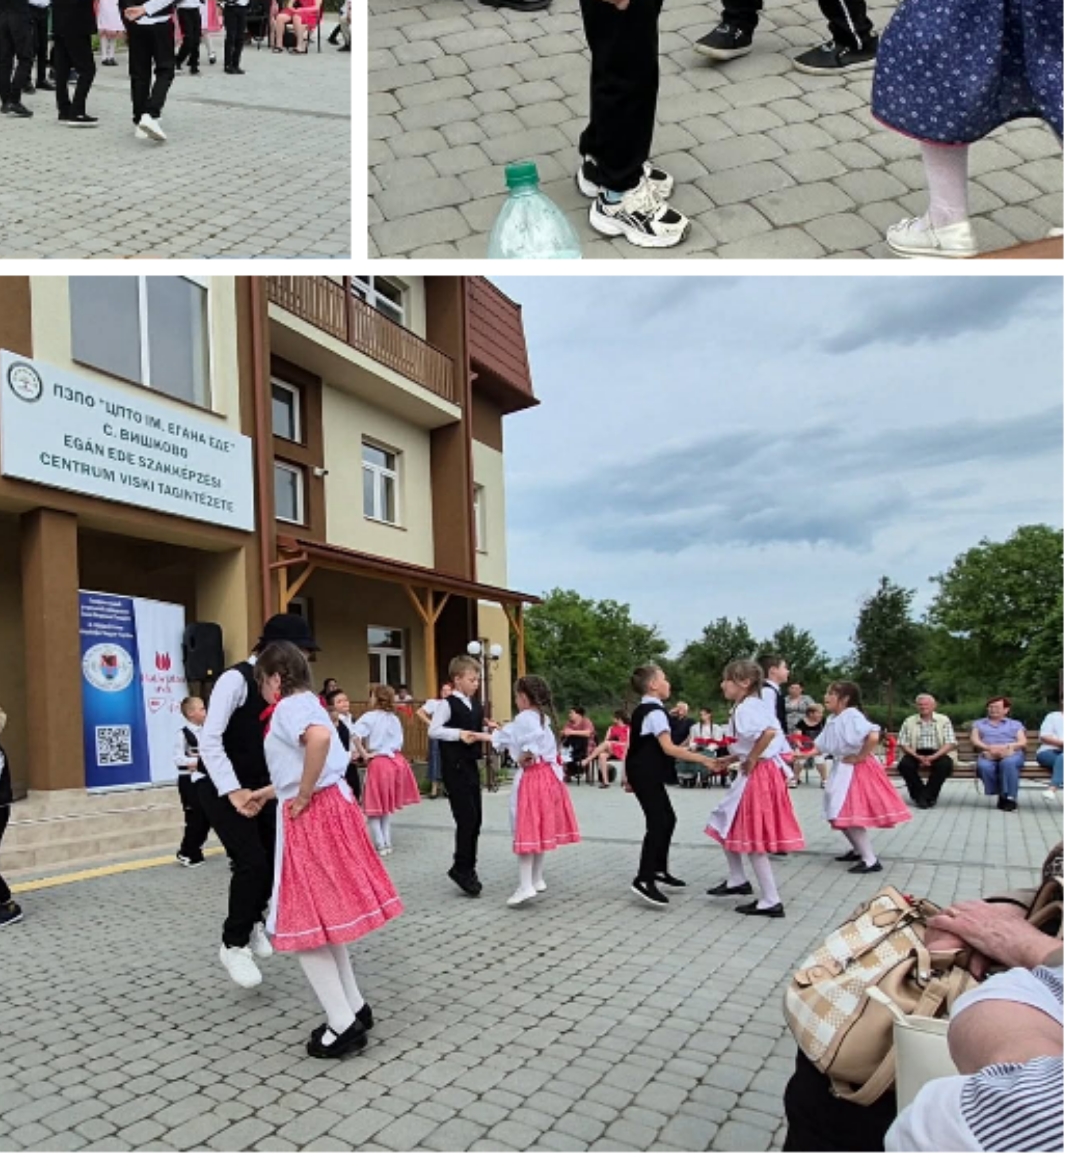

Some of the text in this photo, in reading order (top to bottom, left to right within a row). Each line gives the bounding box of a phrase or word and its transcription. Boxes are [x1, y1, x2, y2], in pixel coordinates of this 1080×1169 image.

[53, 383, 95, 408] ПЗПО
[168, 422, 206, 445] ЕГАНА
[103, 423, 188, 459] С. ВИШКОВО
[39, 451, 234, 513] CENTRUM VISKI TAGINTÉZETE
[64, 434, 222, 489] EGÁN EDE SZAKKÉPZÉSI
